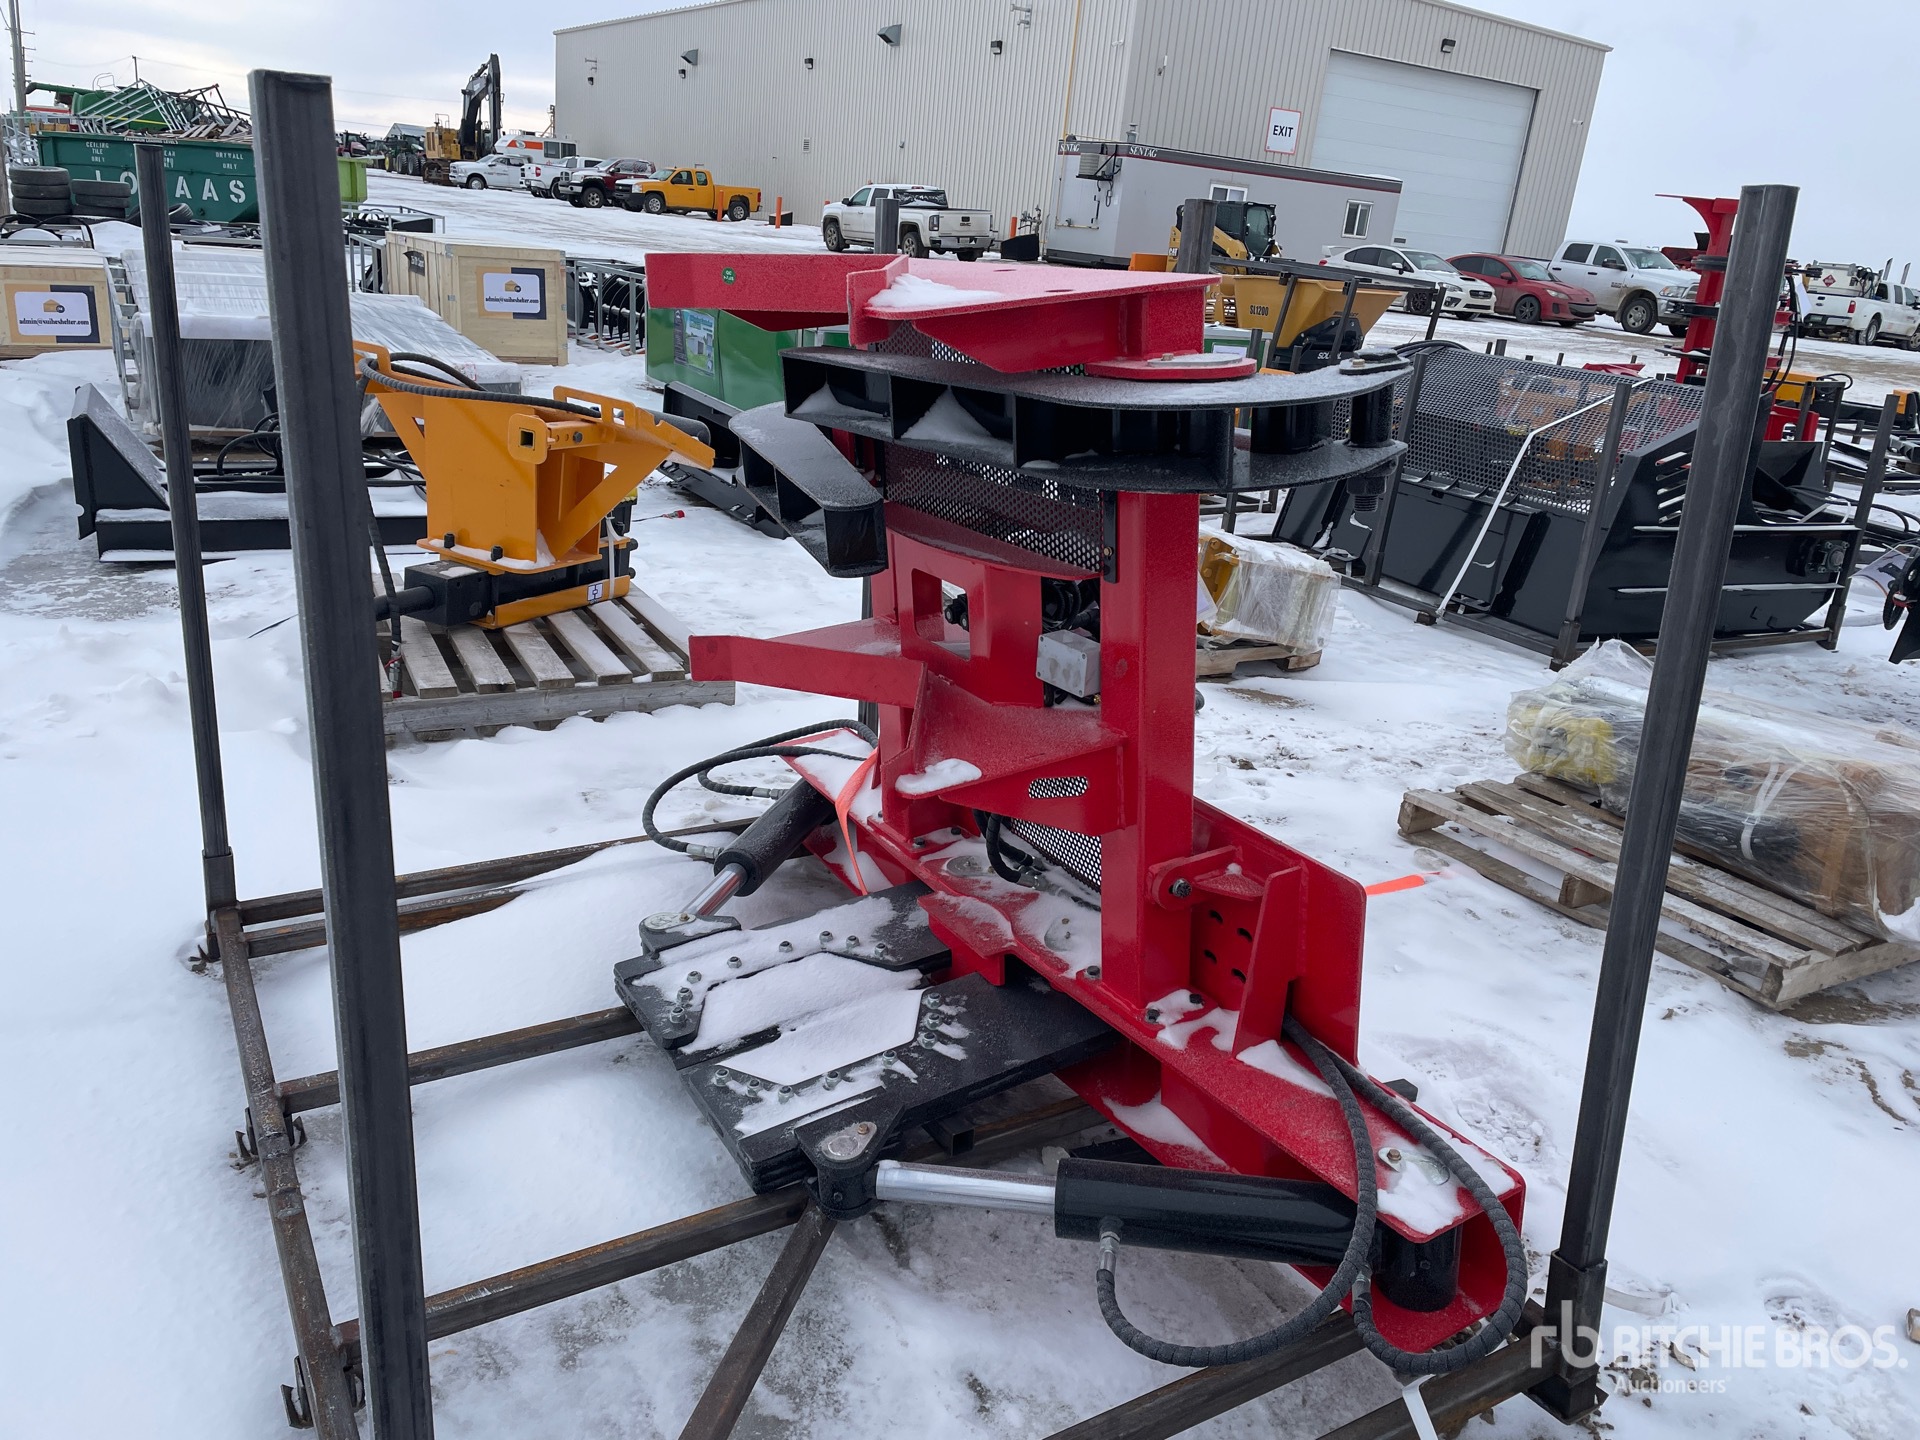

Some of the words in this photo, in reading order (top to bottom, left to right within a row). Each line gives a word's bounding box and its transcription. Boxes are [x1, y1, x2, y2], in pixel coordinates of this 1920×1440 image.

[1273, 125, 1294, 137] EXIT
[215, 152, 244, 160] DRYWALL
[1129, 146, 1158, 157] SENTAG
[1168, 247, 1178, 256] CAT
